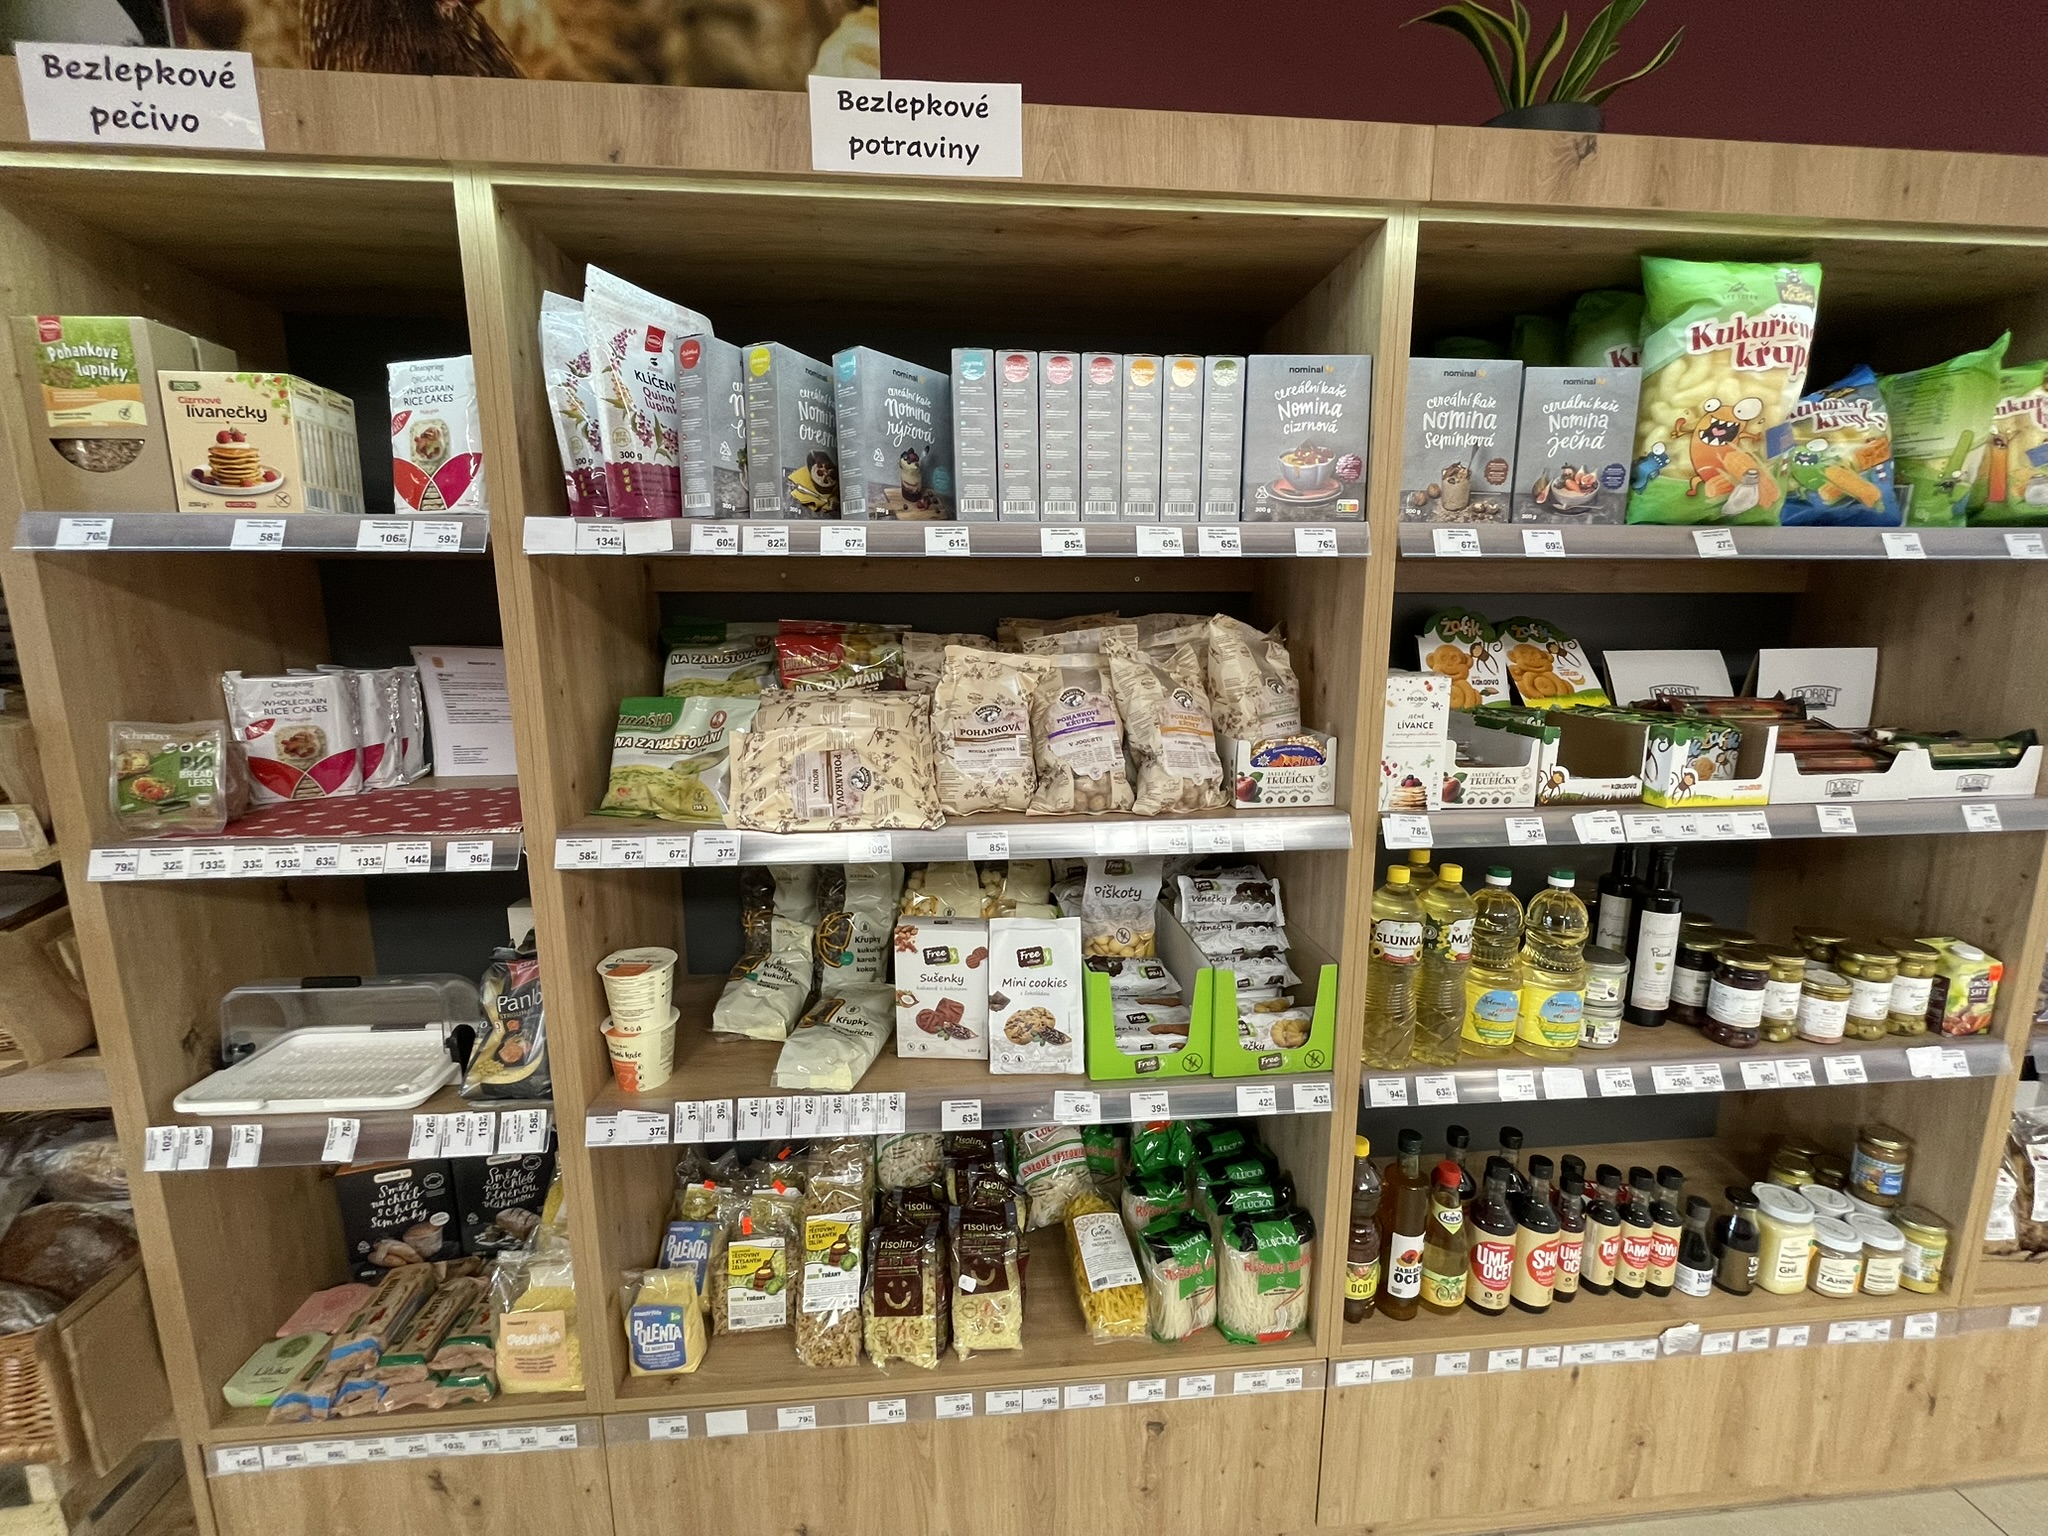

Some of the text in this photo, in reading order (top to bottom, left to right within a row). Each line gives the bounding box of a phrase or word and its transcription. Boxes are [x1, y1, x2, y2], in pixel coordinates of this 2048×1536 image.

[41, 53, 238, 91] Bezlepkové
[837, 89, 989, 121] Bezlepkové
[90, 100, 201, 135] pečivo
[849, 135, 981, 166] potraviny
[47, 341, 119, 361] Pohankové
[76, 360, 128, 382] lupínky
[1288, 365, 1324, 375] nominal
[1443, 369, 1477, 379] nominal
[412, 375, 444, 385] ORGANIC
[892, 368, 919, 383] nominal
[1562, 377, 1597, 386] nominal
[403, 384, 455, 397] WHOLEGRAIN
[1274, 380, 1347, 401] cereální kaše
[403, 394, 454, 407] RICE CAKES
[1426, 390, 1498, 410] cereální kaše
[1542, 394, 1620, 415] cereální kaše
[186, 404, 268, 424] lívanečky
[797, 400, 837, 427] Nomin
[884, 397, 932, 426] Nomina
[1277, 397, 1344, 421] Nomina
[1423, 410, 1498, 432] Nomina
[1548, 412, 1610, 433] Nomina
[1283, 419, 1339, 435] cizrnová
[799, 423, 838, 449] ovesn
[886, 419, 936, 449] rýžová
[1547, 429, 1607, 458] ječná
[619, 450, 634, 460] 300
[259, 532, 273, 542] 58
[379, 534, 400, 543] 106
[437, 535, 451, 544] 59
[595, 537, 614, 547] 134
[716, 538, 729, 548] 60
[767, 539, 780, 548] 82
[845, 539, 858, 548] 67
[948, 539, 961, 548] 61
[1064, 540, 1077, 549] 85
[1162, 539, 1175, 548] 69
[1220, 540, 1233, 549] 65
[1317, 540, 1330, 549] 76
[1461, 540, 1473, 549] 67
[1545, 541, 1557, 550] 69
[671, 653, 689, 665] NA
[262, 698, 328, 708] WHOLEGRAIN
[263, 704, 328, 716] RICE CAKES
[959, 722, 1022, 737] POHANKOVÁ
[1397, 721, 1435, 731] LÍVANCE
[614, 736, 635, 750] NA
[179, 770, 214, 780] BREAD
[187, 779, 213, 788] LESS
[1410, 827, 1422, 835] 78
[1527, 829, 1538, 838] 32
[989, 843, 1001, 852] 85
[470, 854, 483, 863] 96
[579, 852, 591, 861] 58
[624, 851, 636, 861] 67
[669, 850, 681, 859] 67
[717, 849, 729, 858] 37
[199, 860, 218, 870] 133
[275, 859, 294, 869] 133
[315, 857, 329, 866] 63
[356, 858, 375, 867] 133
[404, 855, 423, 865] 144
[115, 863, 127, 873] 79
[1094, 883, 1142, 902] Piškoty
[854, 935, 881, 946] Křupky
[1376, 931, 1423, 948] SLUNKA
[925, 948, 948, 960] Free
[1019, 950, 1042, 961] Free
[919, 973, 965, 987] Sušenky
[1001, 976, 1069, 990] Mini cookies
[836, 1015, 870, 1027] Křupky
[1389, 1090, 1400, 1098] 94
[1435, 1088, 1446, 1096] 63
[1258, 1098, 1269, 1107] 42
[1313, 1095, 1324, 1104] 43
[776, 1103, 785, 1117] 42
[890, 1099, 899, 1112] 42
[1074, 1104, 1086, 1113] 66
[1151, 1104, 1162, 1113] 39
[750, 1104, 759, 1118] 41
[962, 1114, 974, 1123] 63
[529, 1116, 539, 1134] 158
[649, 1127, 661, 1136] 37
[1476, 1244, 1509, 1265] UME
[1560, 1246, 1583, 1261] UME
[1482, 1259, 1513, 1281] OCET
[1351, 1281, 1373, 1294] OCOT
[633, 1319, 683, 1345] POLENTA
[955, 1403, 966, 1412] 59
[1005, 1400, 1016, 1408] 59
[888, 1409, 899, 1417] 61
